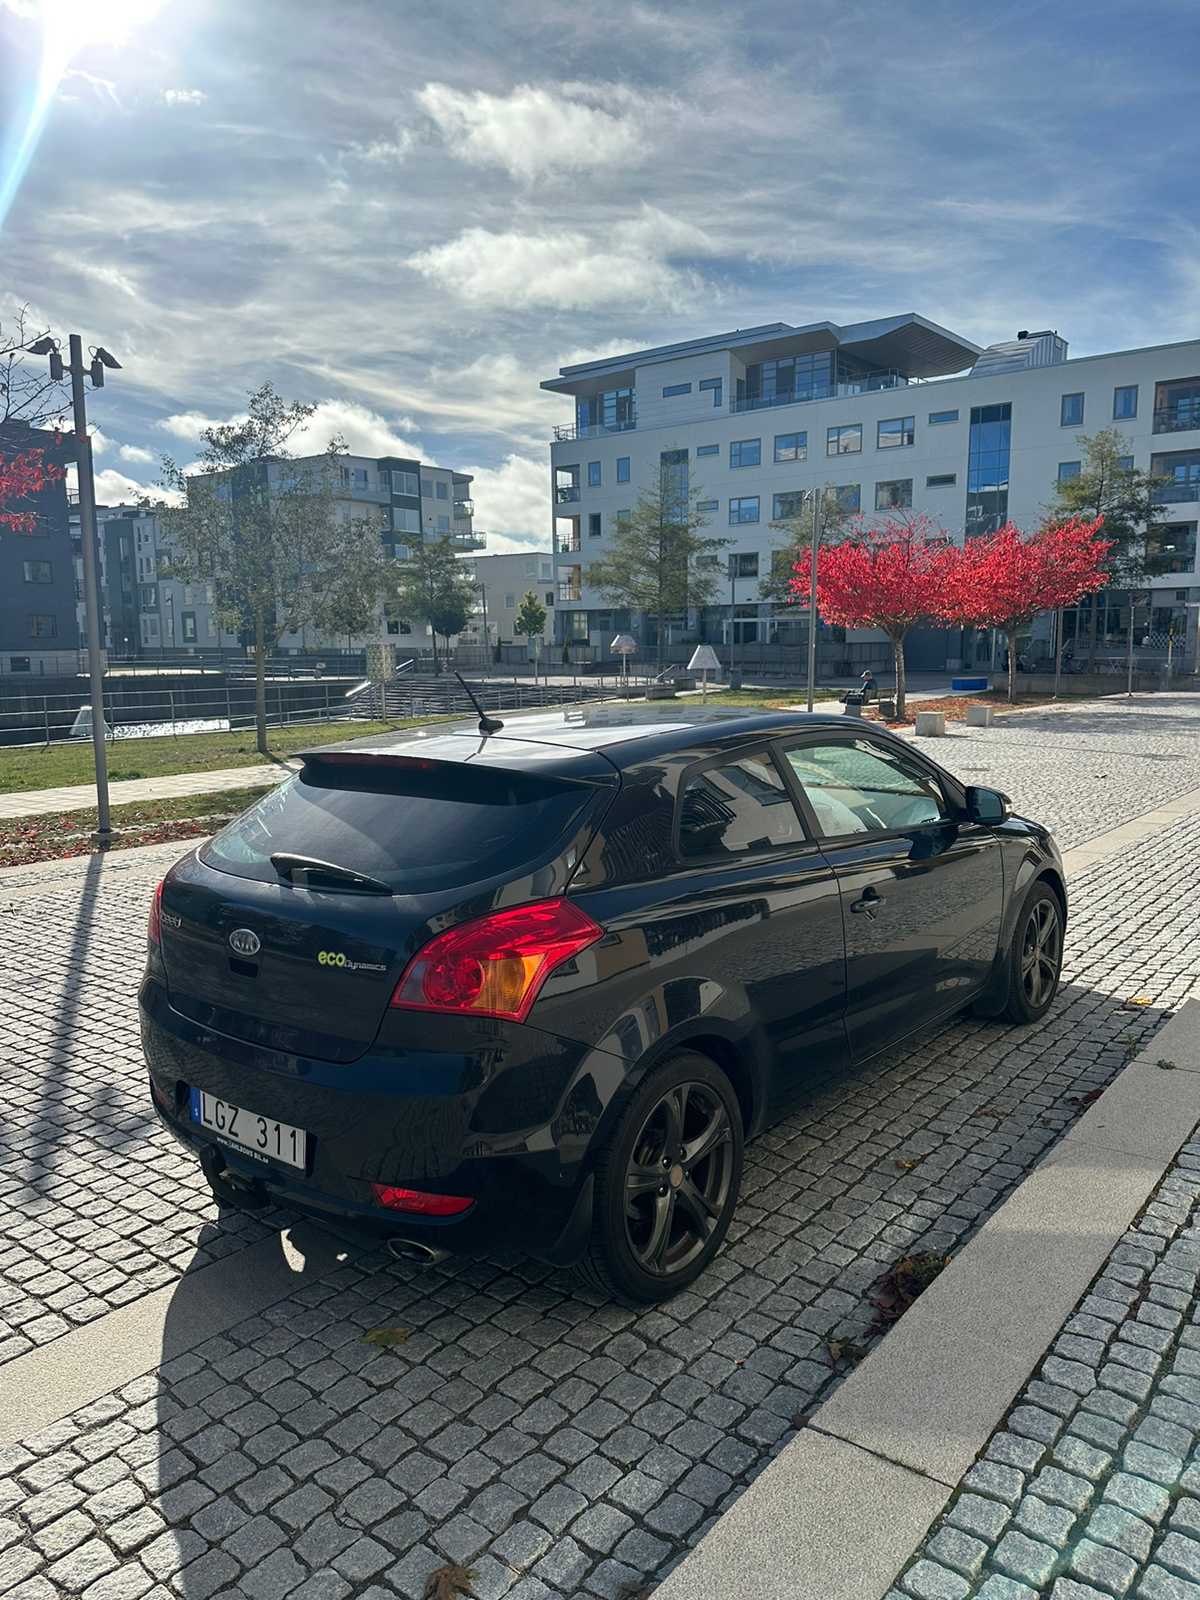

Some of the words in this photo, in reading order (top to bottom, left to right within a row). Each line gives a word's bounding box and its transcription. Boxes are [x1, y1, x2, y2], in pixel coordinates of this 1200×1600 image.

[231, 931, 257, 953] KIA
[194, 1107, 199, 1117] S
[202, 1093, 239, 1138] LGZ
[256, 1117, 297, 1162] 311
